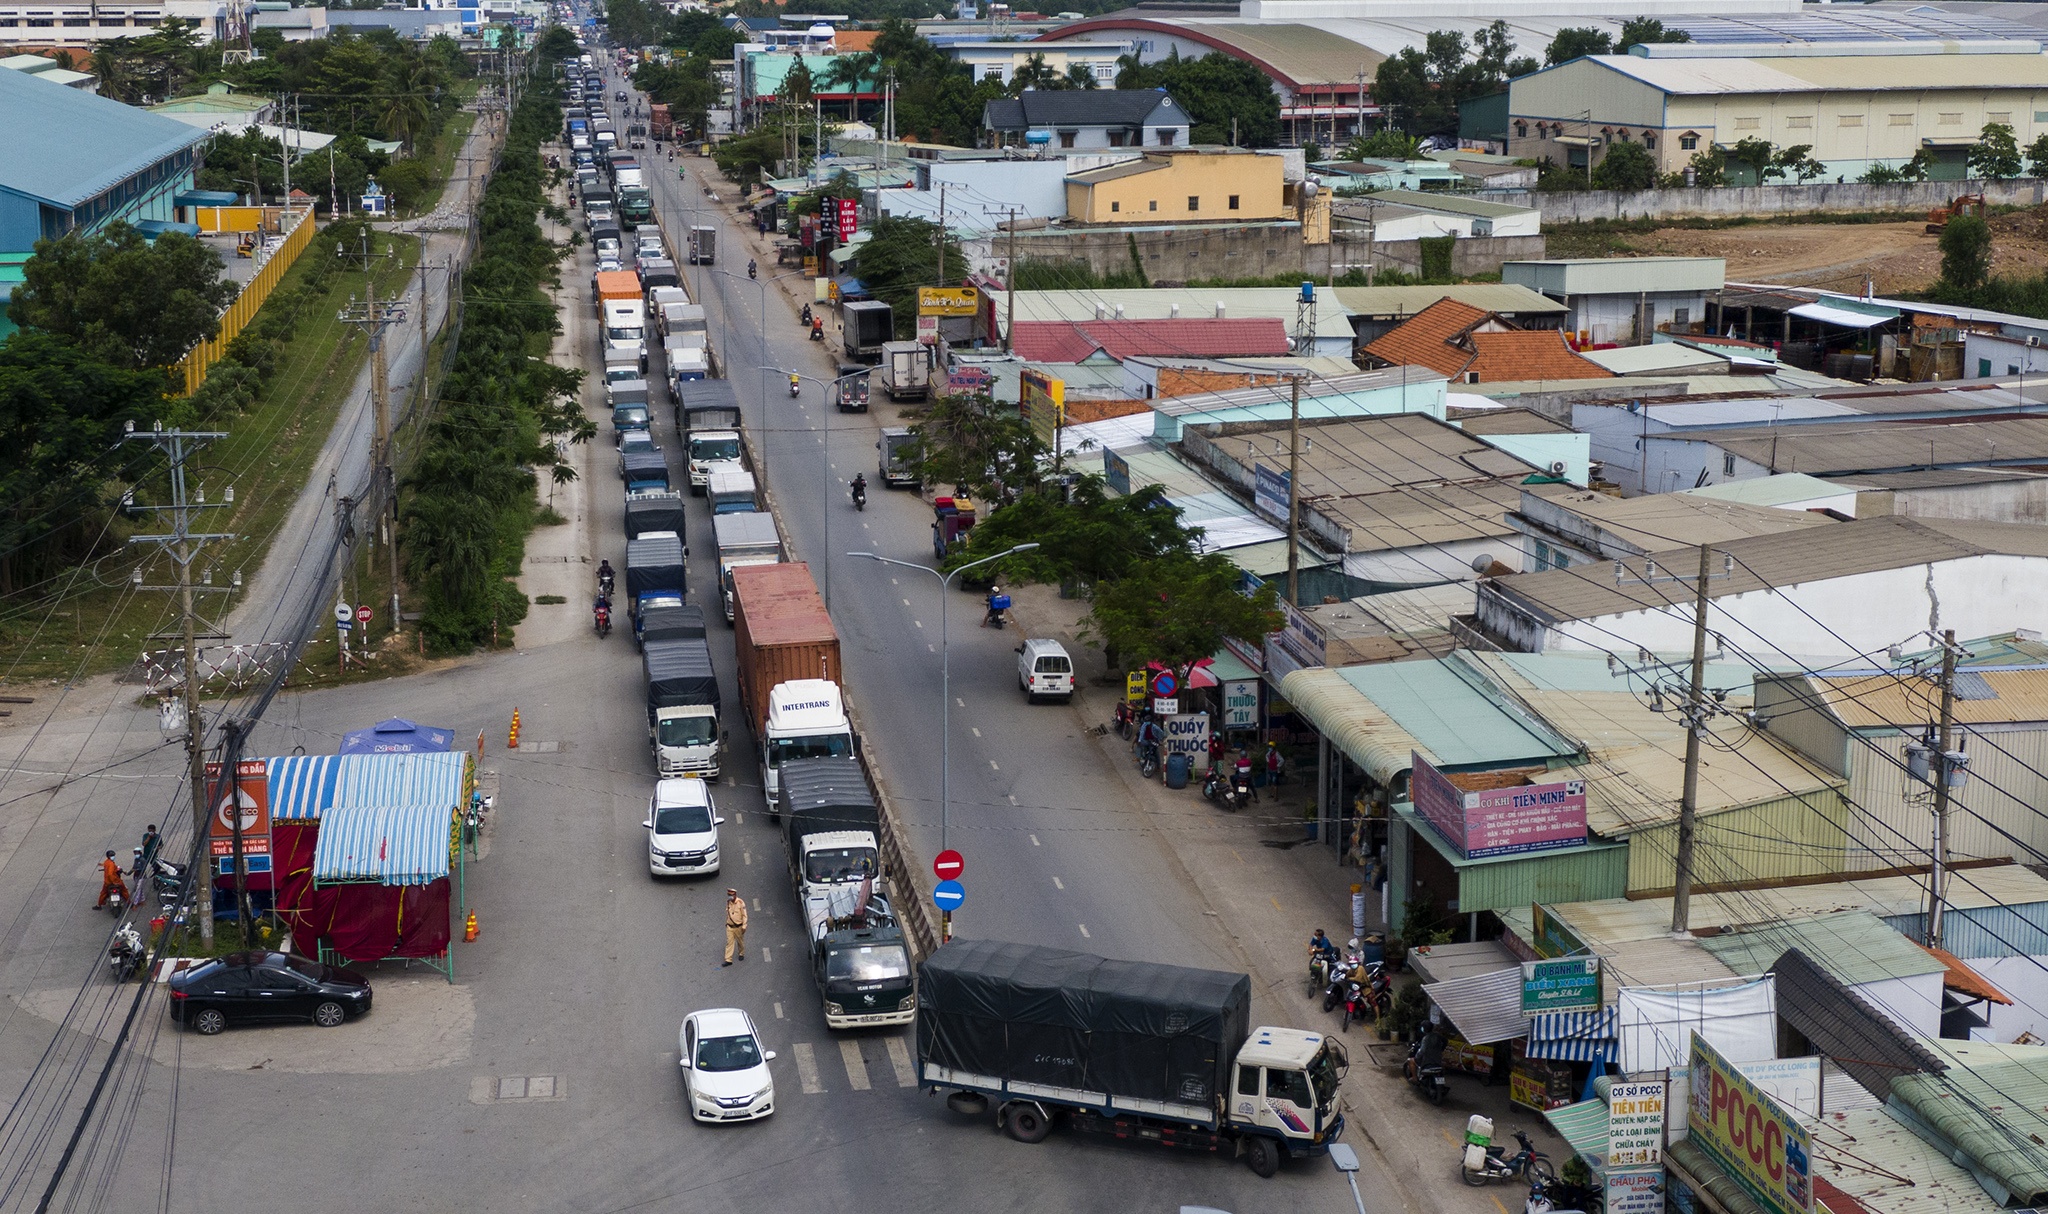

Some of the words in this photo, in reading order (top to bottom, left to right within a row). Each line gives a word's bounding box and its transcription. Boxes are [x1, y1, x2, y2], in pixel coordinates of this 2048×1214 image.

[359, 610, 370, 618] STOP
[782, 701, 830, 711] INTERTRANS
[1233, 709, 1250, 722] TÂY
[375, 744, 411, 752] Mobil
[1167, 735, 1208, 752] THUỐC
[1513, 789, 1537, 808] TIẾN
[1539, 790, 1565, 805] MINH
[249, 860, 267, 868] Easy
[1557, 977, 1595, 989] XANH
[1768, 1063, 1786, 1072] PCCC
[1788, 1062, 1807, 1071] LONG
[1612, 1087, 1624, 1097] CƠ
[1626, 1084, 1638, 1096] SỞ
[1640, 1085, 1662, 1095] PCCC
[1612, 1099, 1635, 1114] TIÊN
[1638, 1096, 1661, 1113] TIẾN
[1745, 1081, 1754, 1096] TM
[1781, 1113, 1797, 1134] LONG
[1637, 1115, 1648, 1124] NẠP
[1649, 1115, 1661, 1124] SẠC
[1711, 1068, 1783, 1182] PCCC
[1610, 1128, 1624, 1137] CÁC
[1626, 1128, 1642, 1138] LOẠI
[1644, 1126, 1661, 1135] BÌNH
[1615, 1140, 1634, 1149] CHỮA
[1636, 1139, 1655, 1148] CHÁY
[1637, 1176, 1657, 1184] PHA
